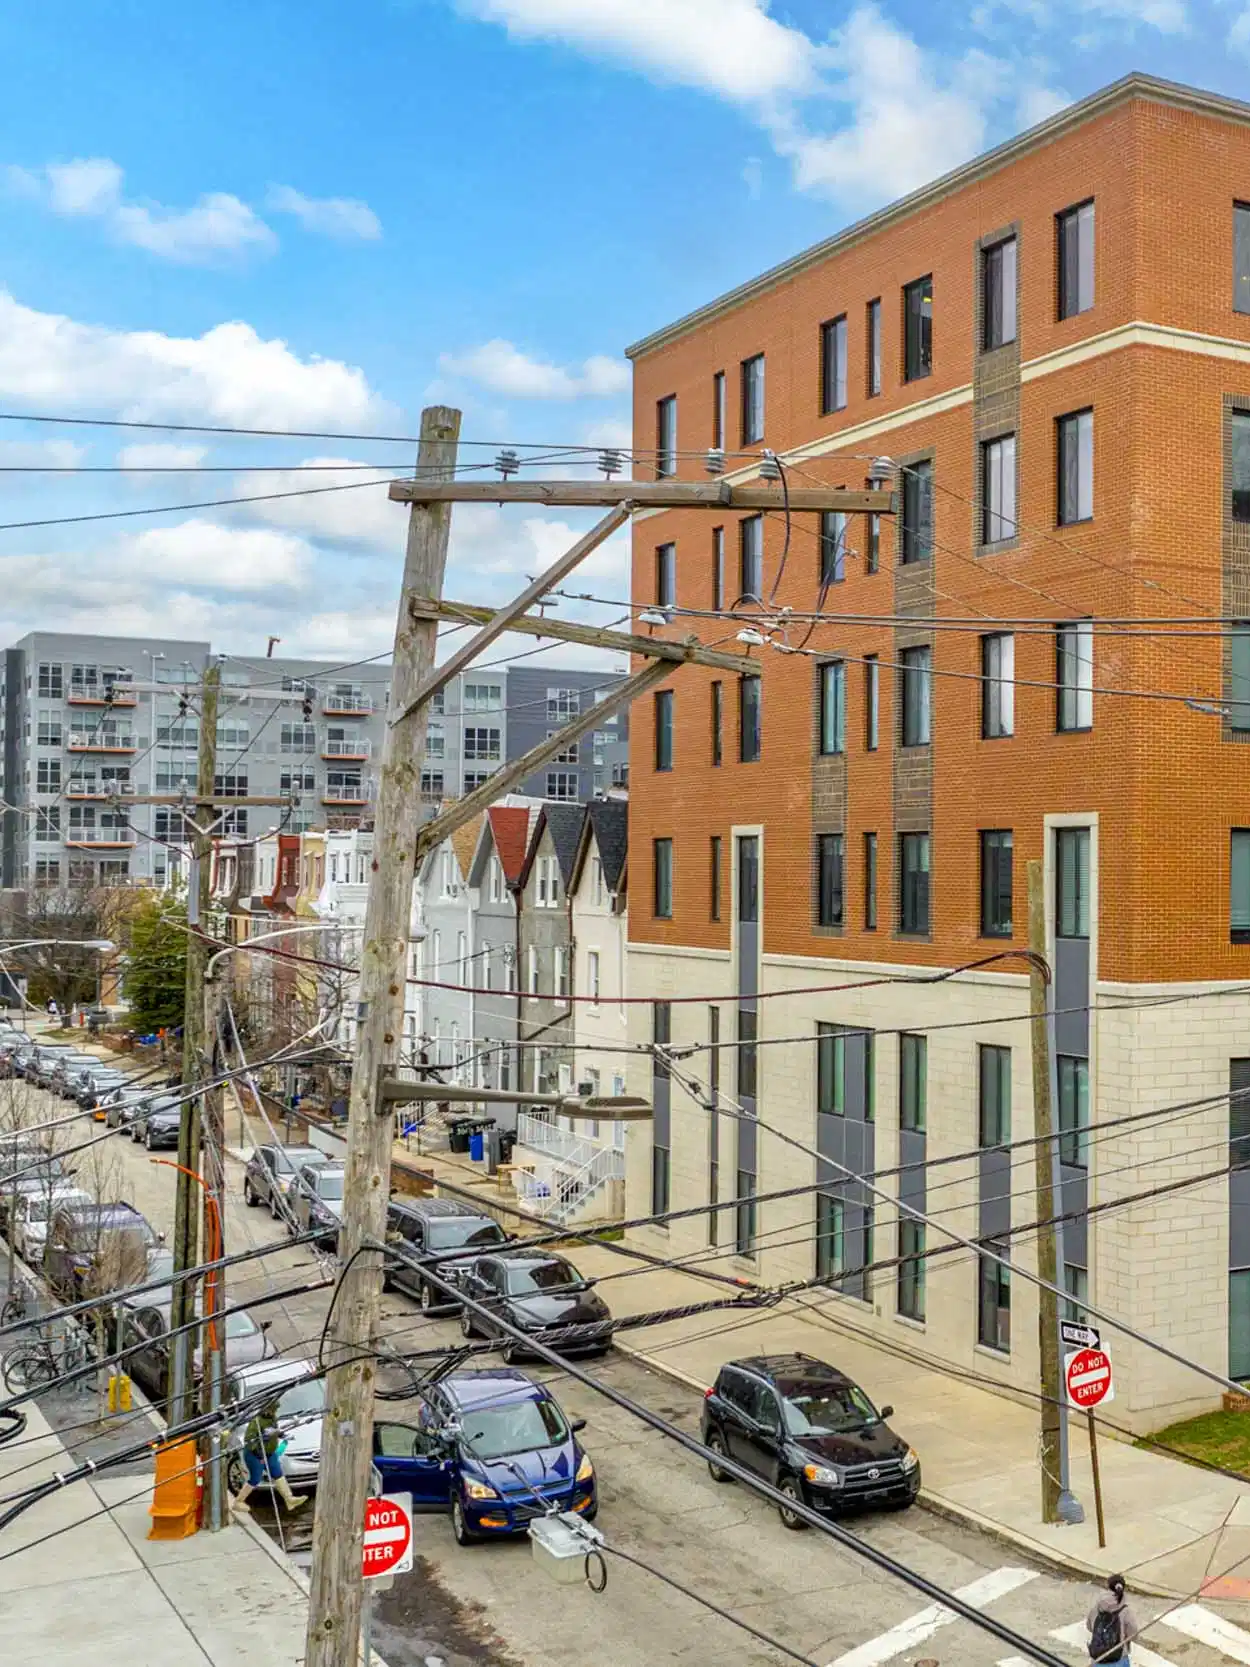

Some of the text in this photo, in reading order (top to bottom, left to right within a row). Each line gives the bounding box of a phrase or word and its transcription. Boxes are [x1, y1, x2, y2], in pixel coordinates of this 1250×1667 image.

[1077, 1331, 1089, 1340] WAY
[1072, 1355, 1104, 1374] DO NOT
[1077, 1382, 1104, 1399] ENTER
[369, 1510, 398, 1526] NOT
[363, 1546, 393, 1562] TER
